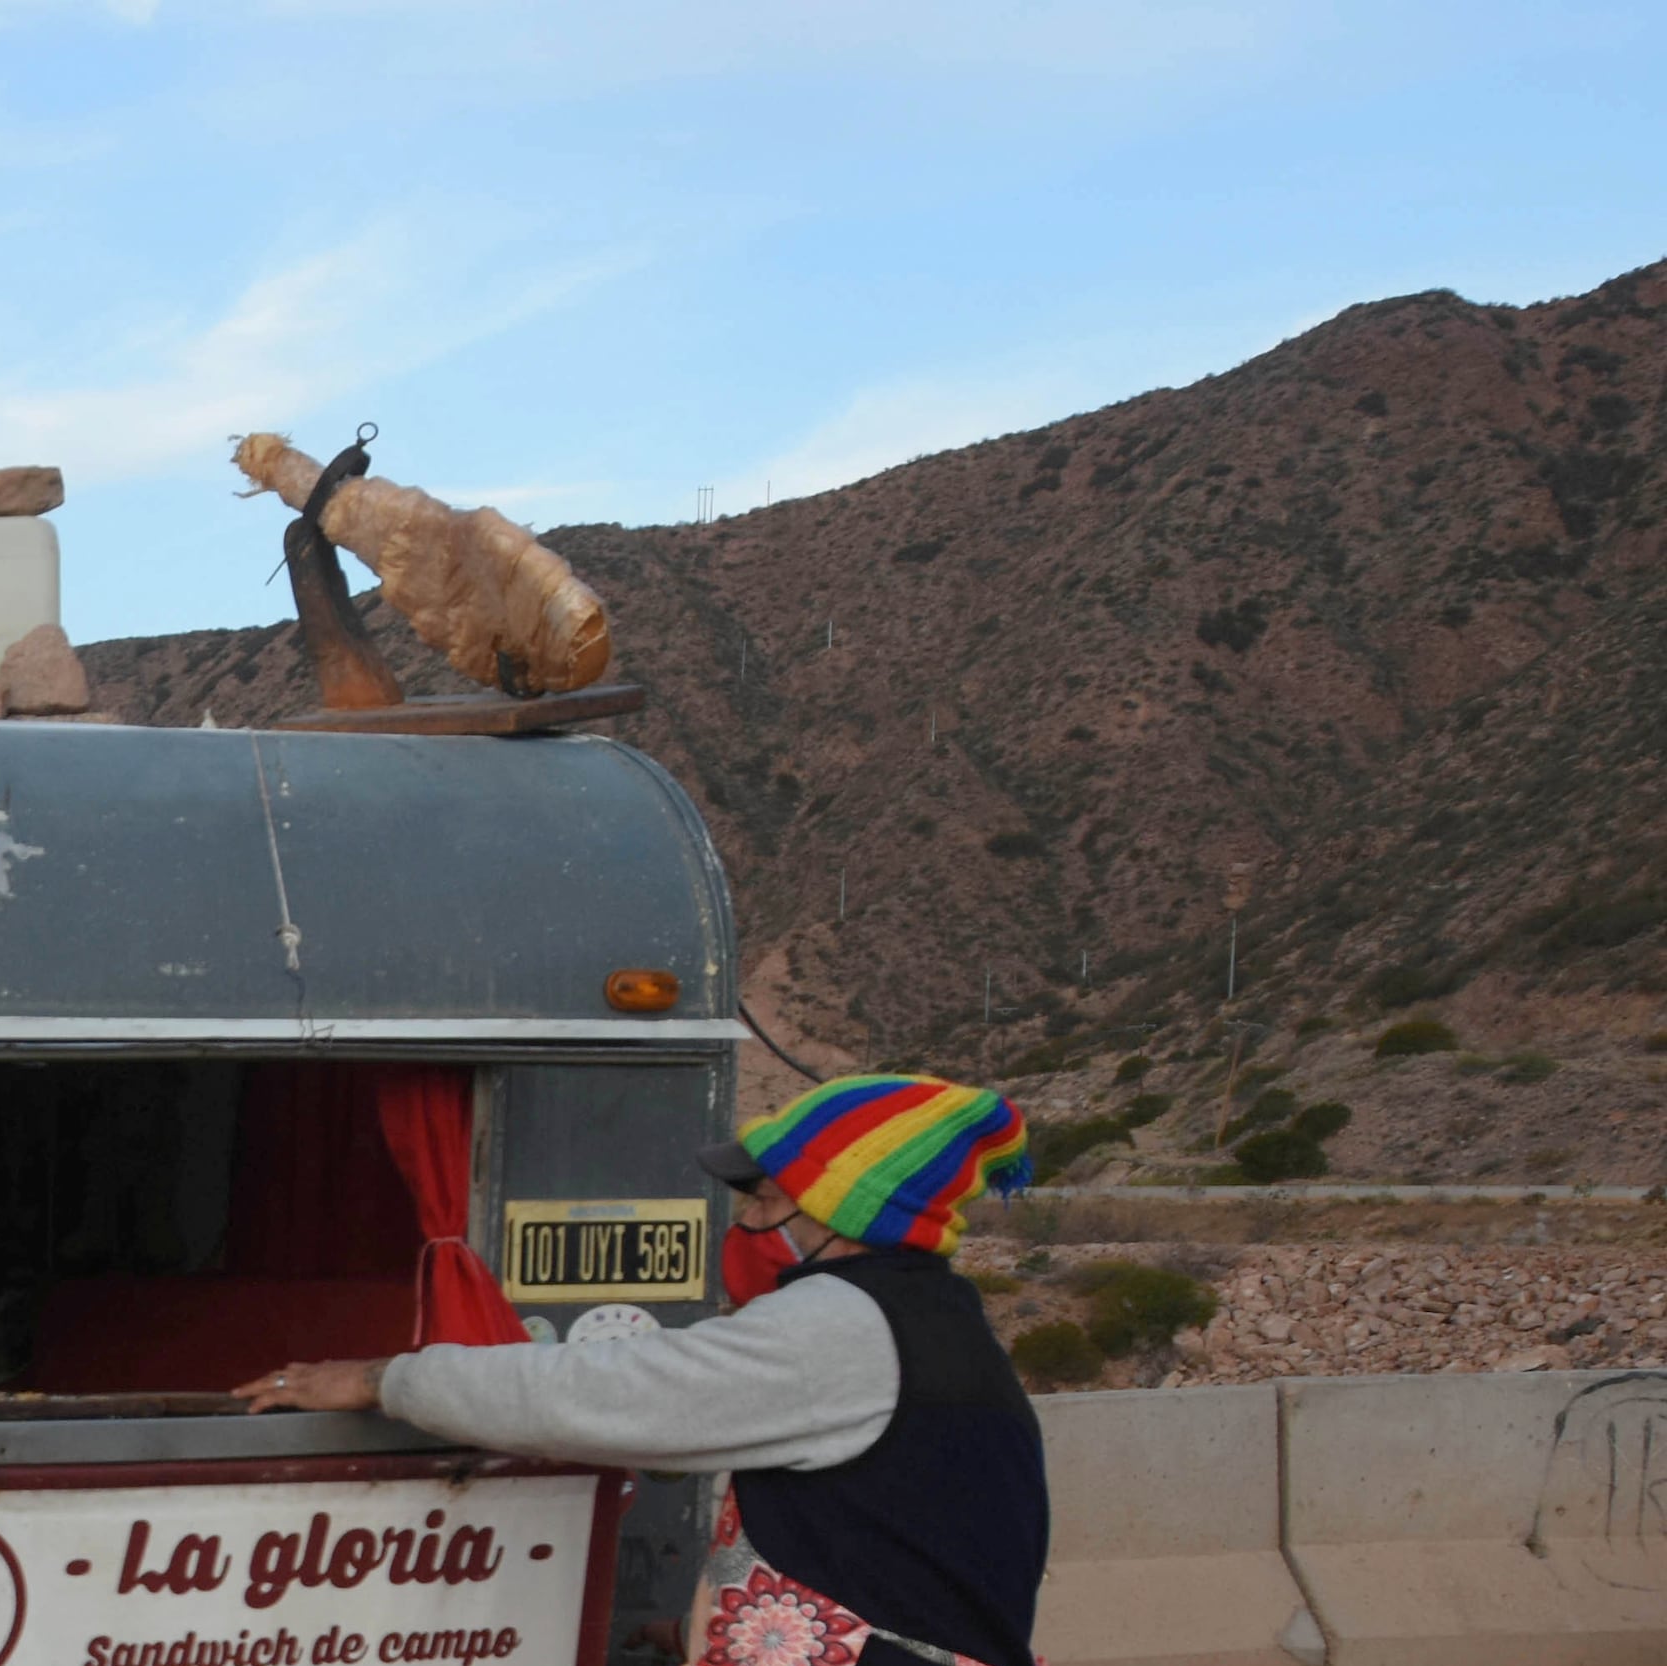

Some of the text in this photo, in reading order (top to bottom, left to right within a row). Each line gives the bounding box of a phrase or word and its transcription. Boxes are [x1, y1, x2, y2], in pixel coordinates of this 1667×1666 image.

[524, 1223, 687, 1283] 101 UYI 585
[117, 1511, 502, 1608] La gloria
[310, 1625, 369, 1666] de
